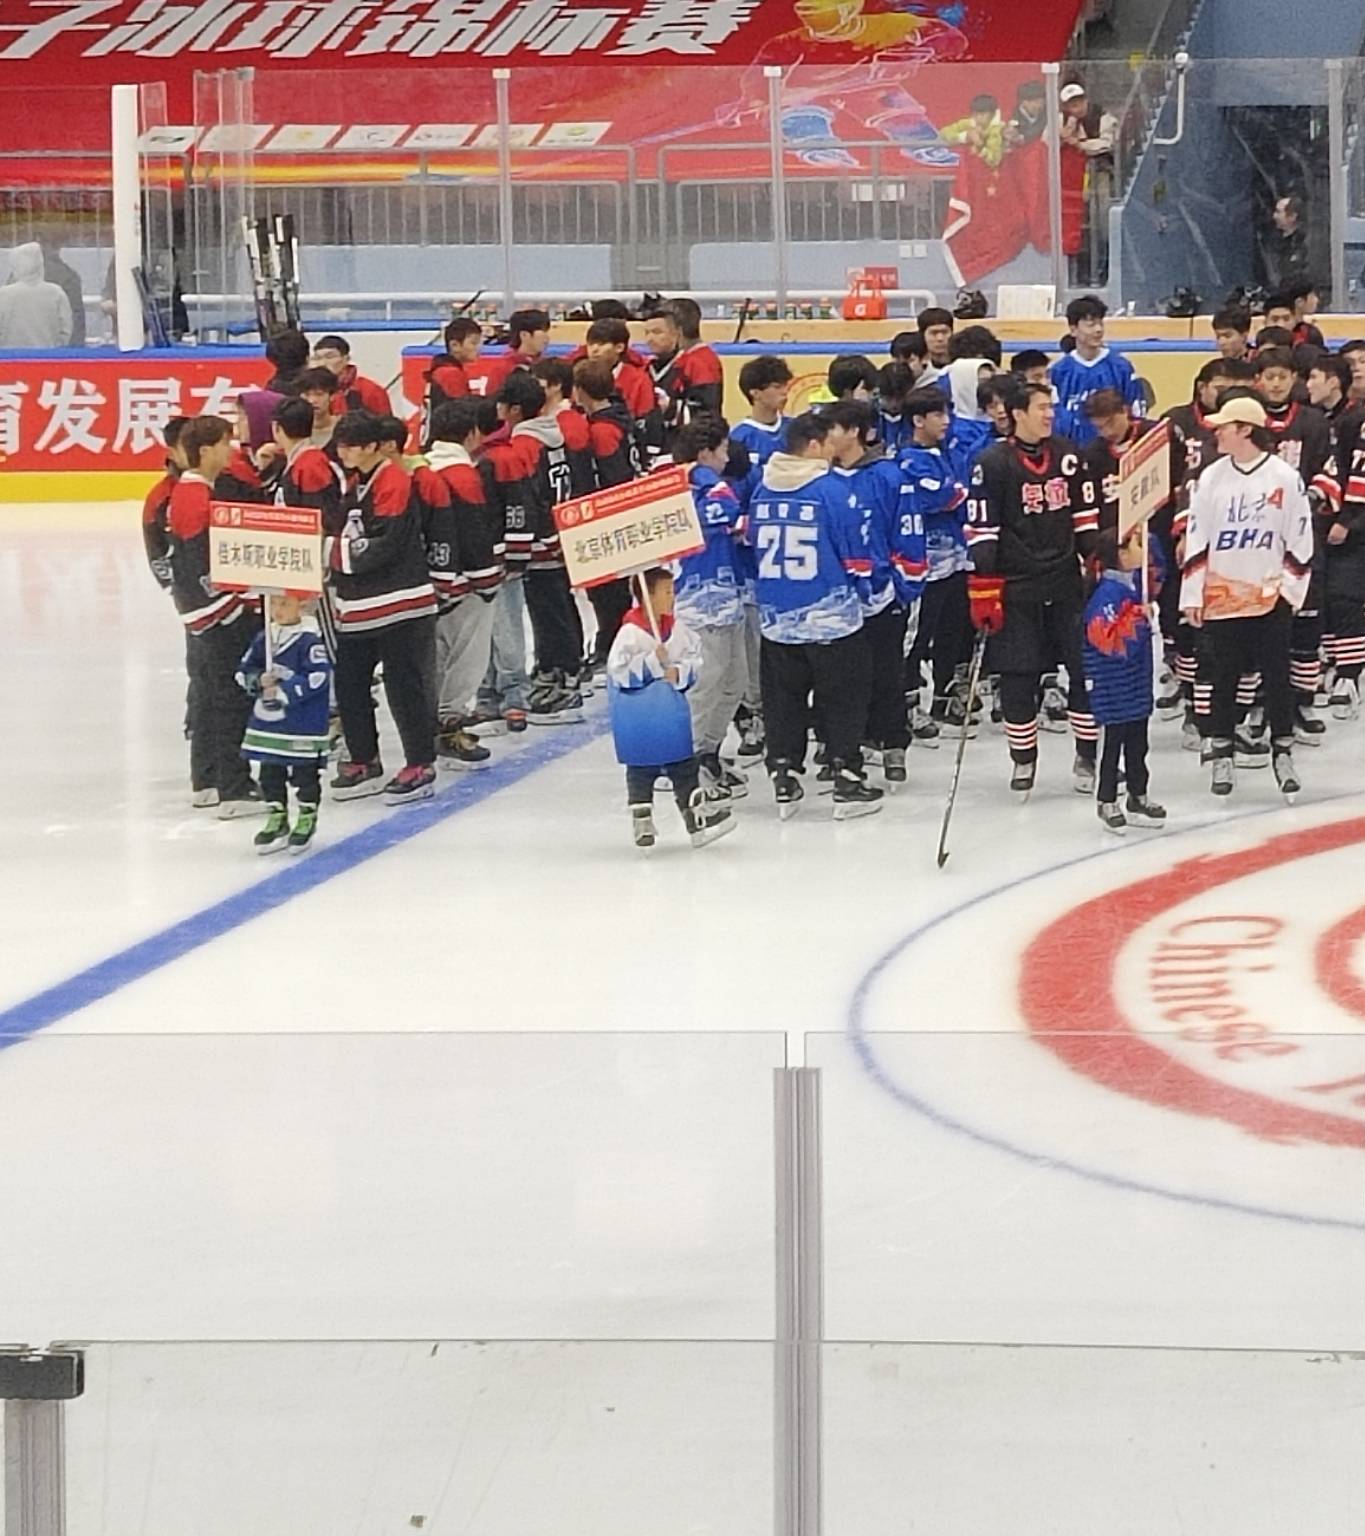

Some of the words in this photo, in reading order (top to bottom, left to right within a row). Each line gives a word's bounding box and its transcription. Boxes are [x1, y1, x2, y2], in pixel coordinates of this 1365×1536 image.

[1061, 454, 1079, 476] C
[1215, 528, 1274, 552] BHA
[1149, 915, 1302, 1062] Chinese
